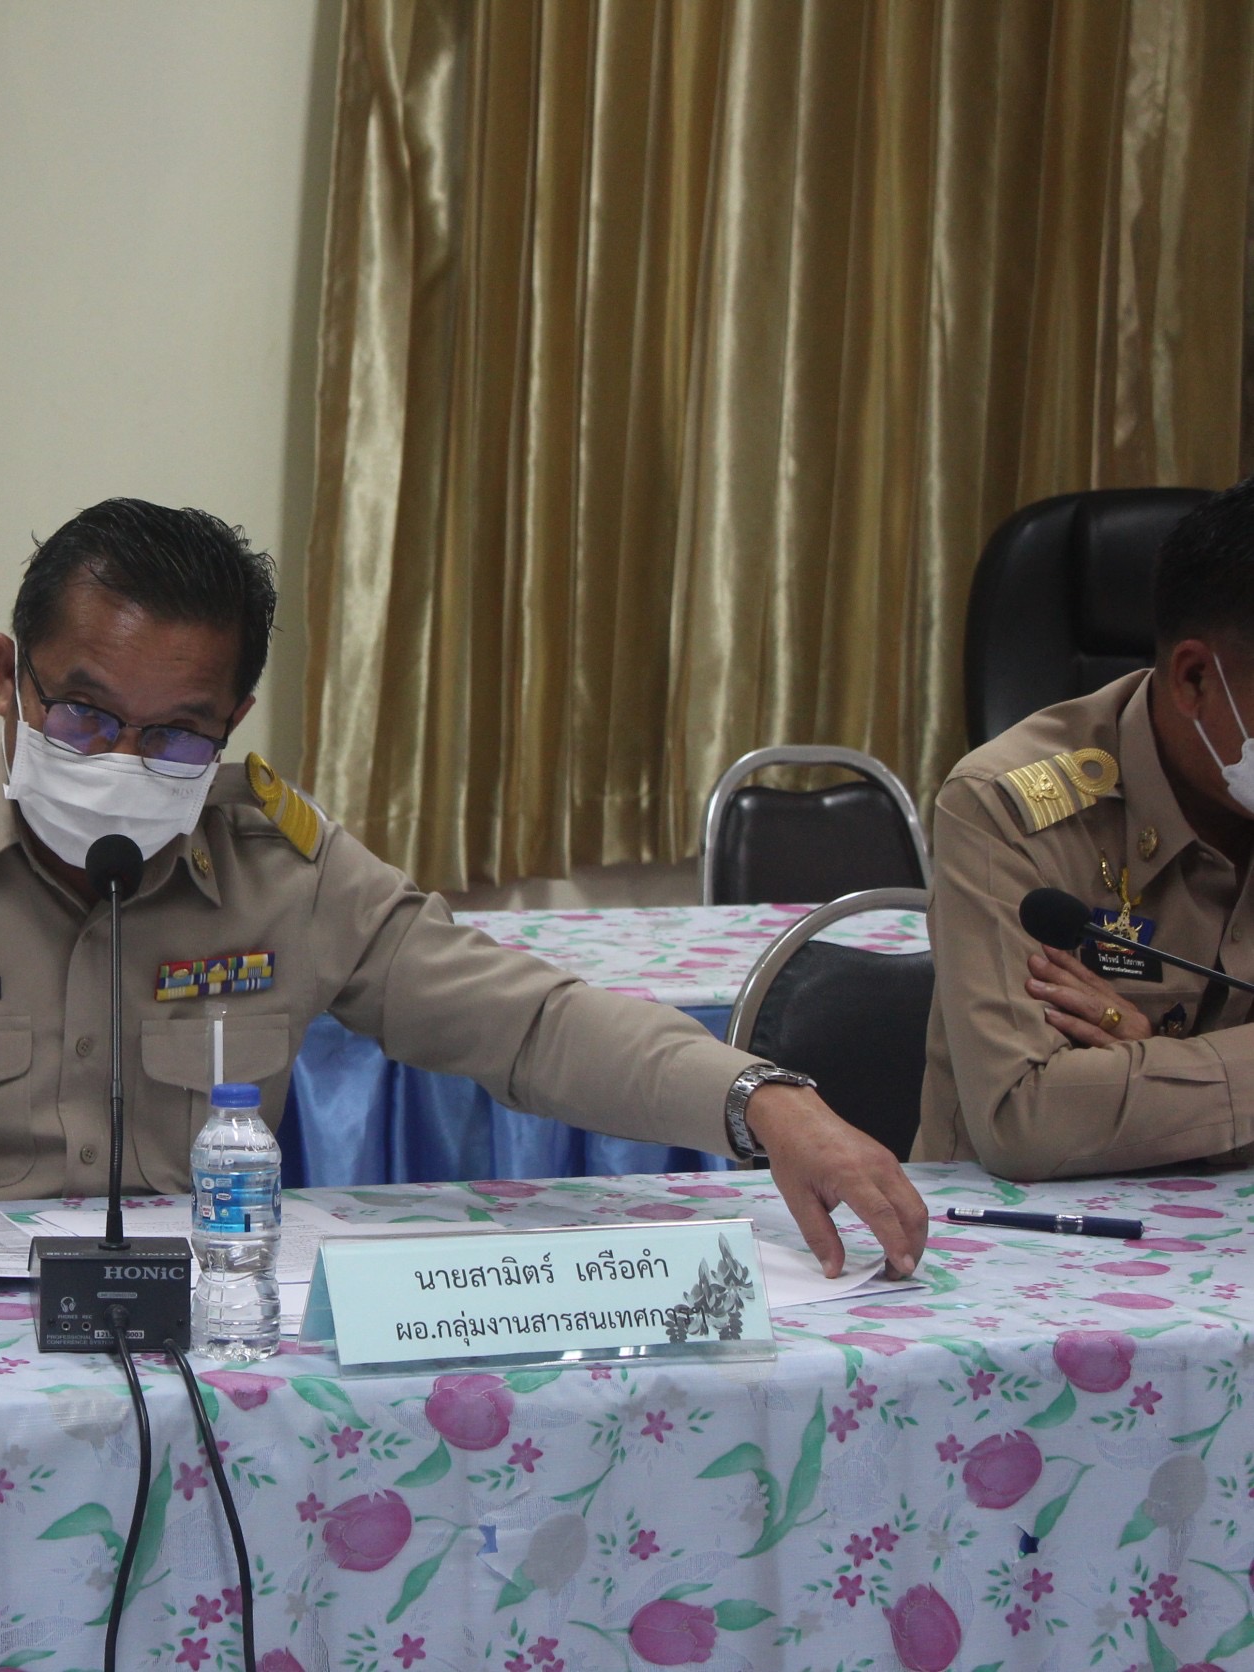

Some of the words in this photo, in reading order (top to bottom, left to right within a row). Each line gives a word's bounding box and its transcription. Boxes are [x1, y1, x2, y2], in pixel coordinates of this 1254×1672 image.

[414, 1252, 554, 1291] นายสามิตร์
[575, 1248, 669, 1282] เครือคำ
